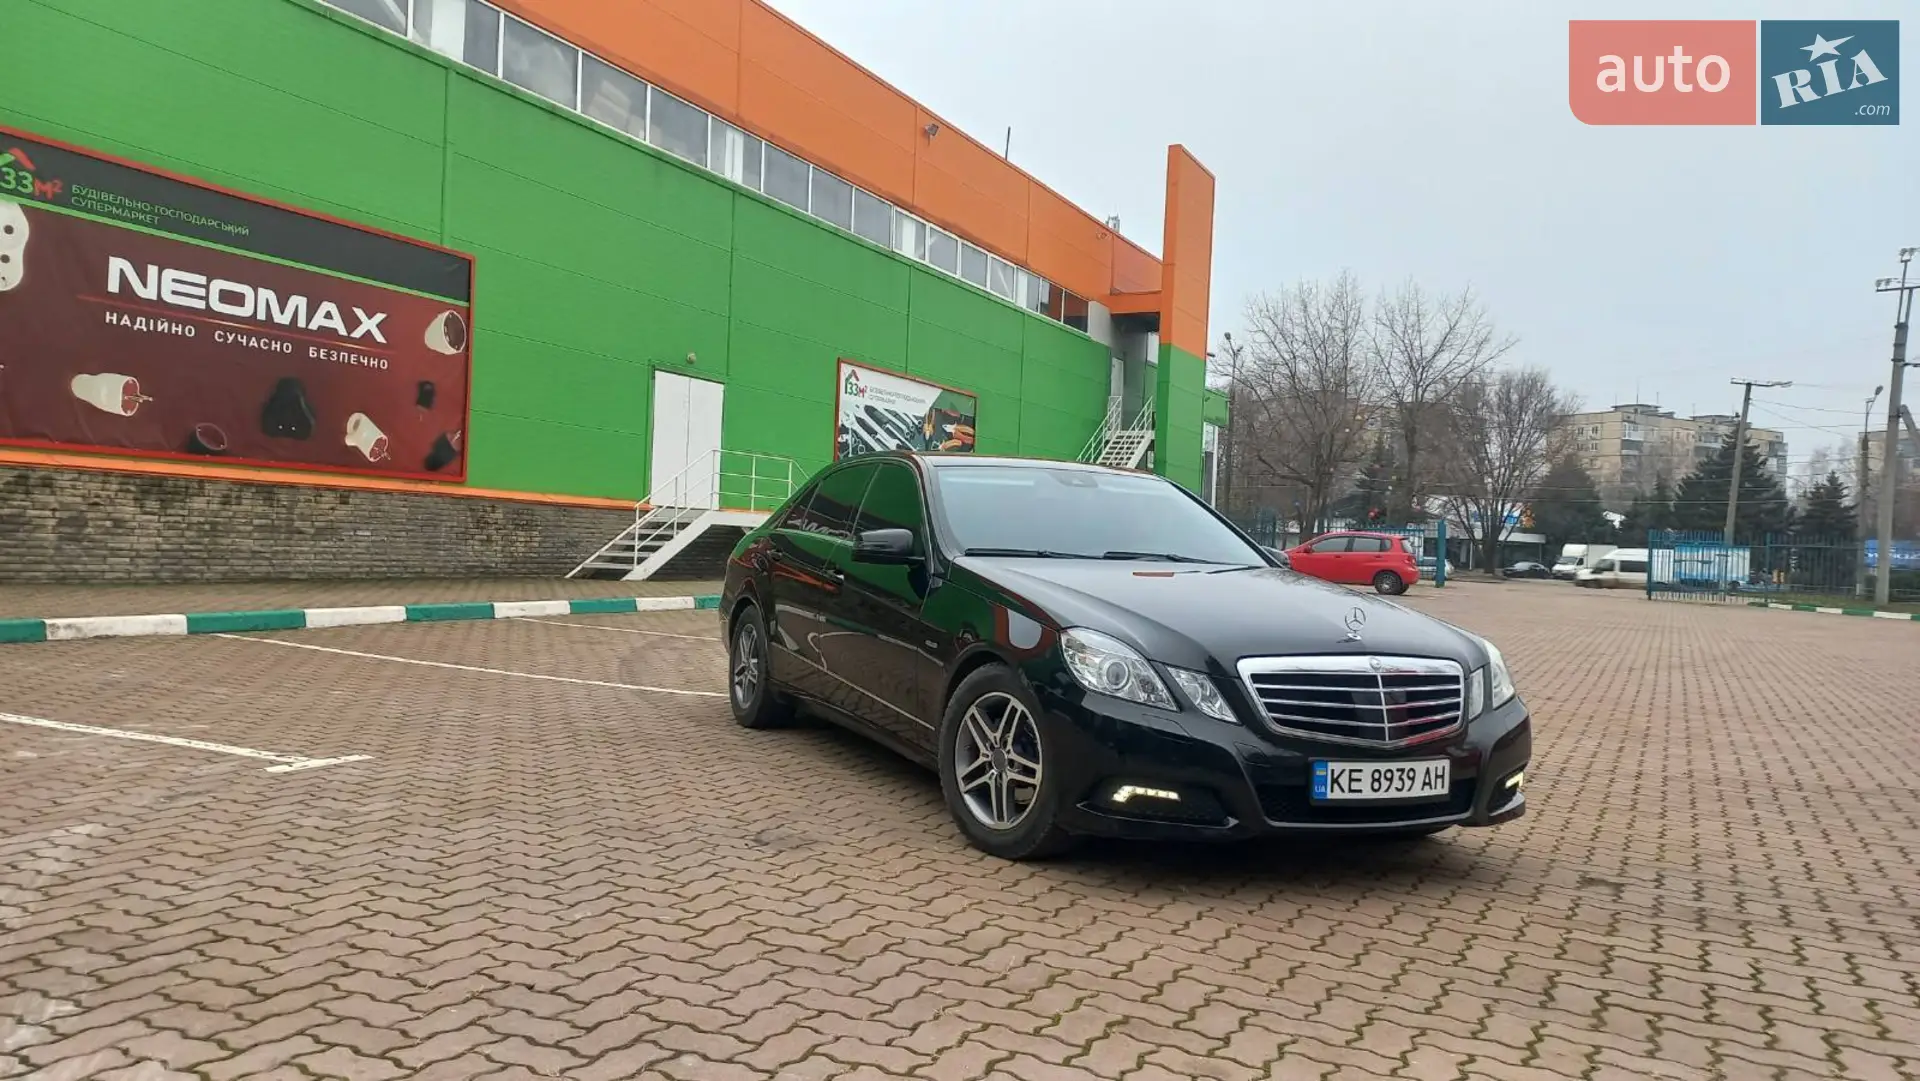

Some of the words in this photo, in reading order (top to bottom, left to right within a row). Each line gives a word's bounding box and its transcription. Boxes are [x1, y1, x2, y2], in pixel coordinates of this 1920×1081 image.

[71, 196, 161, 225] СУПЕРМАРКЕТ
[106, 255, 388, 344] NEOMAX
[105, 310, 196, 338] НАДІЙНО
[214, 329, 293, 355] СУЧАСНО
[308, 346, 389, 370] БЕЗПЕЧНО
[1330, 768, 1363, 794] KE
[1370, 767, 1416, 793] 8939
[1421, 765, 1446, 791] AH
